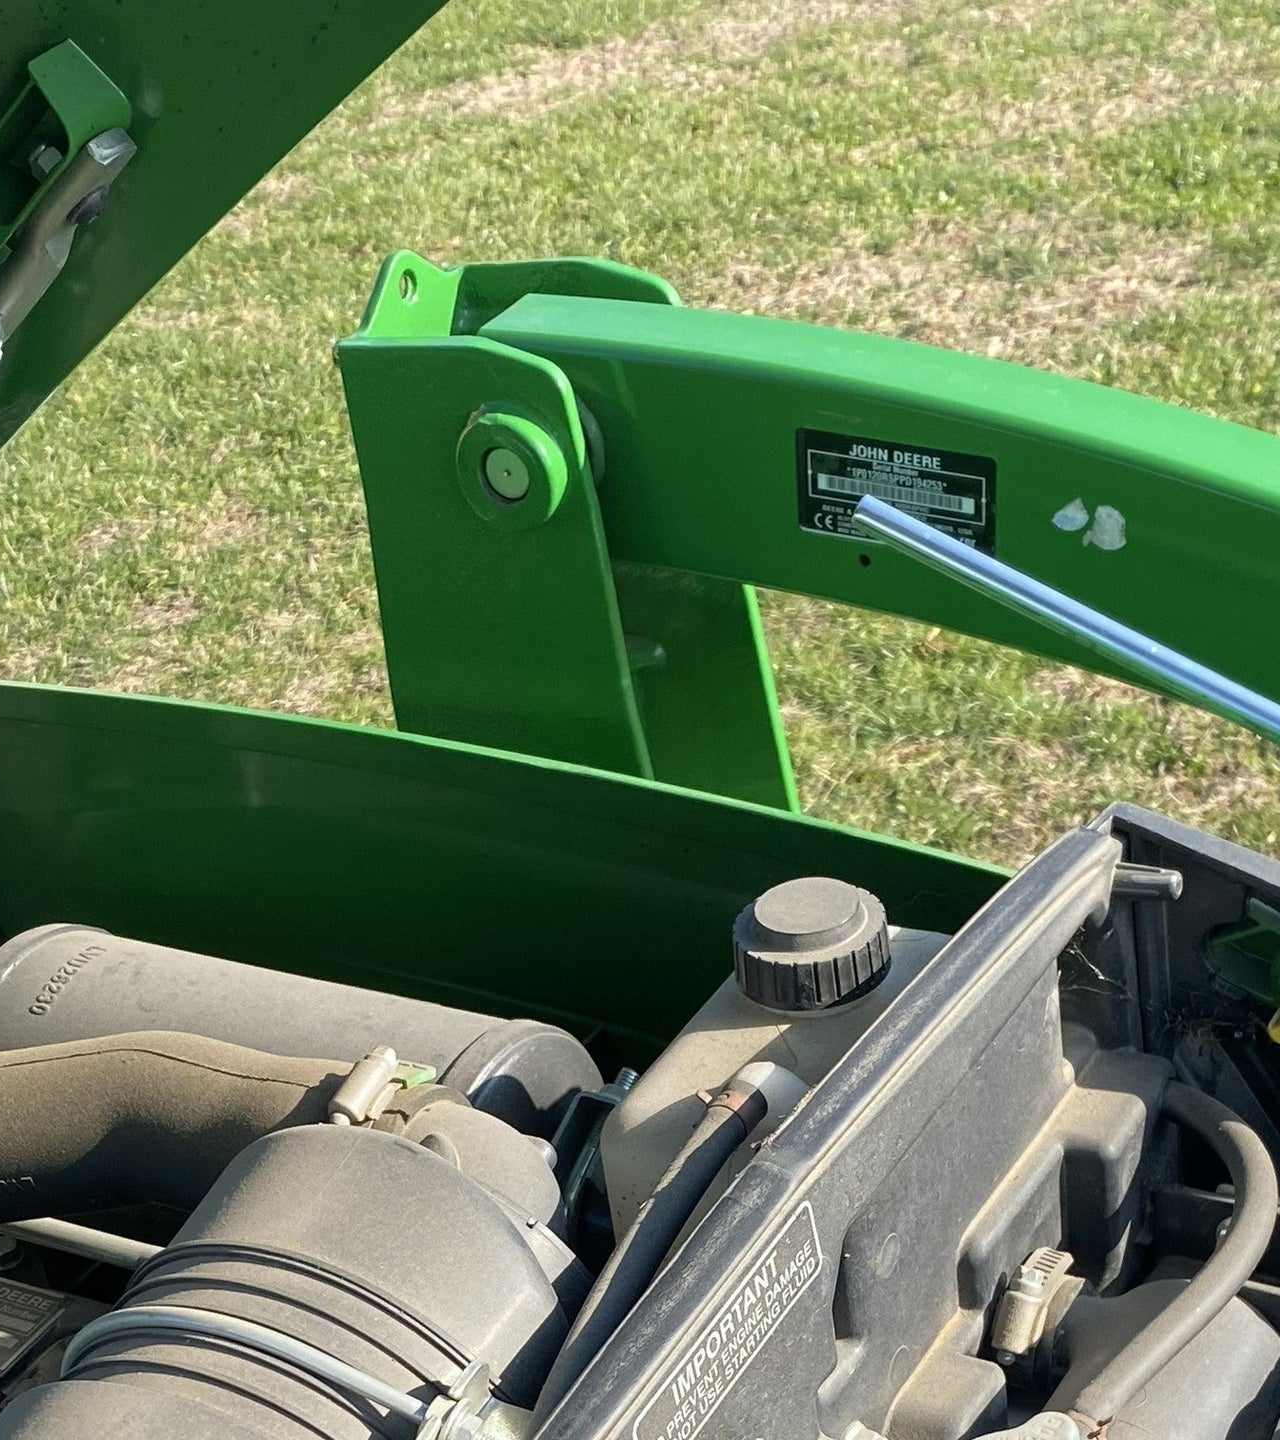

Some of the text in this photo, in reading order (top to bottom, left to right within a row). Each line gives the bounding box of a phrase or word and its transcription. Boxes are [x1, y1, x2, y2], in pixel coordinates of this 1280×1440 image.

[848, 444, 942, 470] JOHN DEERE
[666, 1362, 721, 1435] PREVENT
[722, 1306, 766, 1366] ENGINE
[765, 1239, 813, 1306] DAMAGE
[671, 1249, 779, 1406] IMPORTANT
[698, 1376, 726, 1415] USE
[723, 1304, 782, 1380] STARTING
[782, 1256, 816, 1305] FLUID
